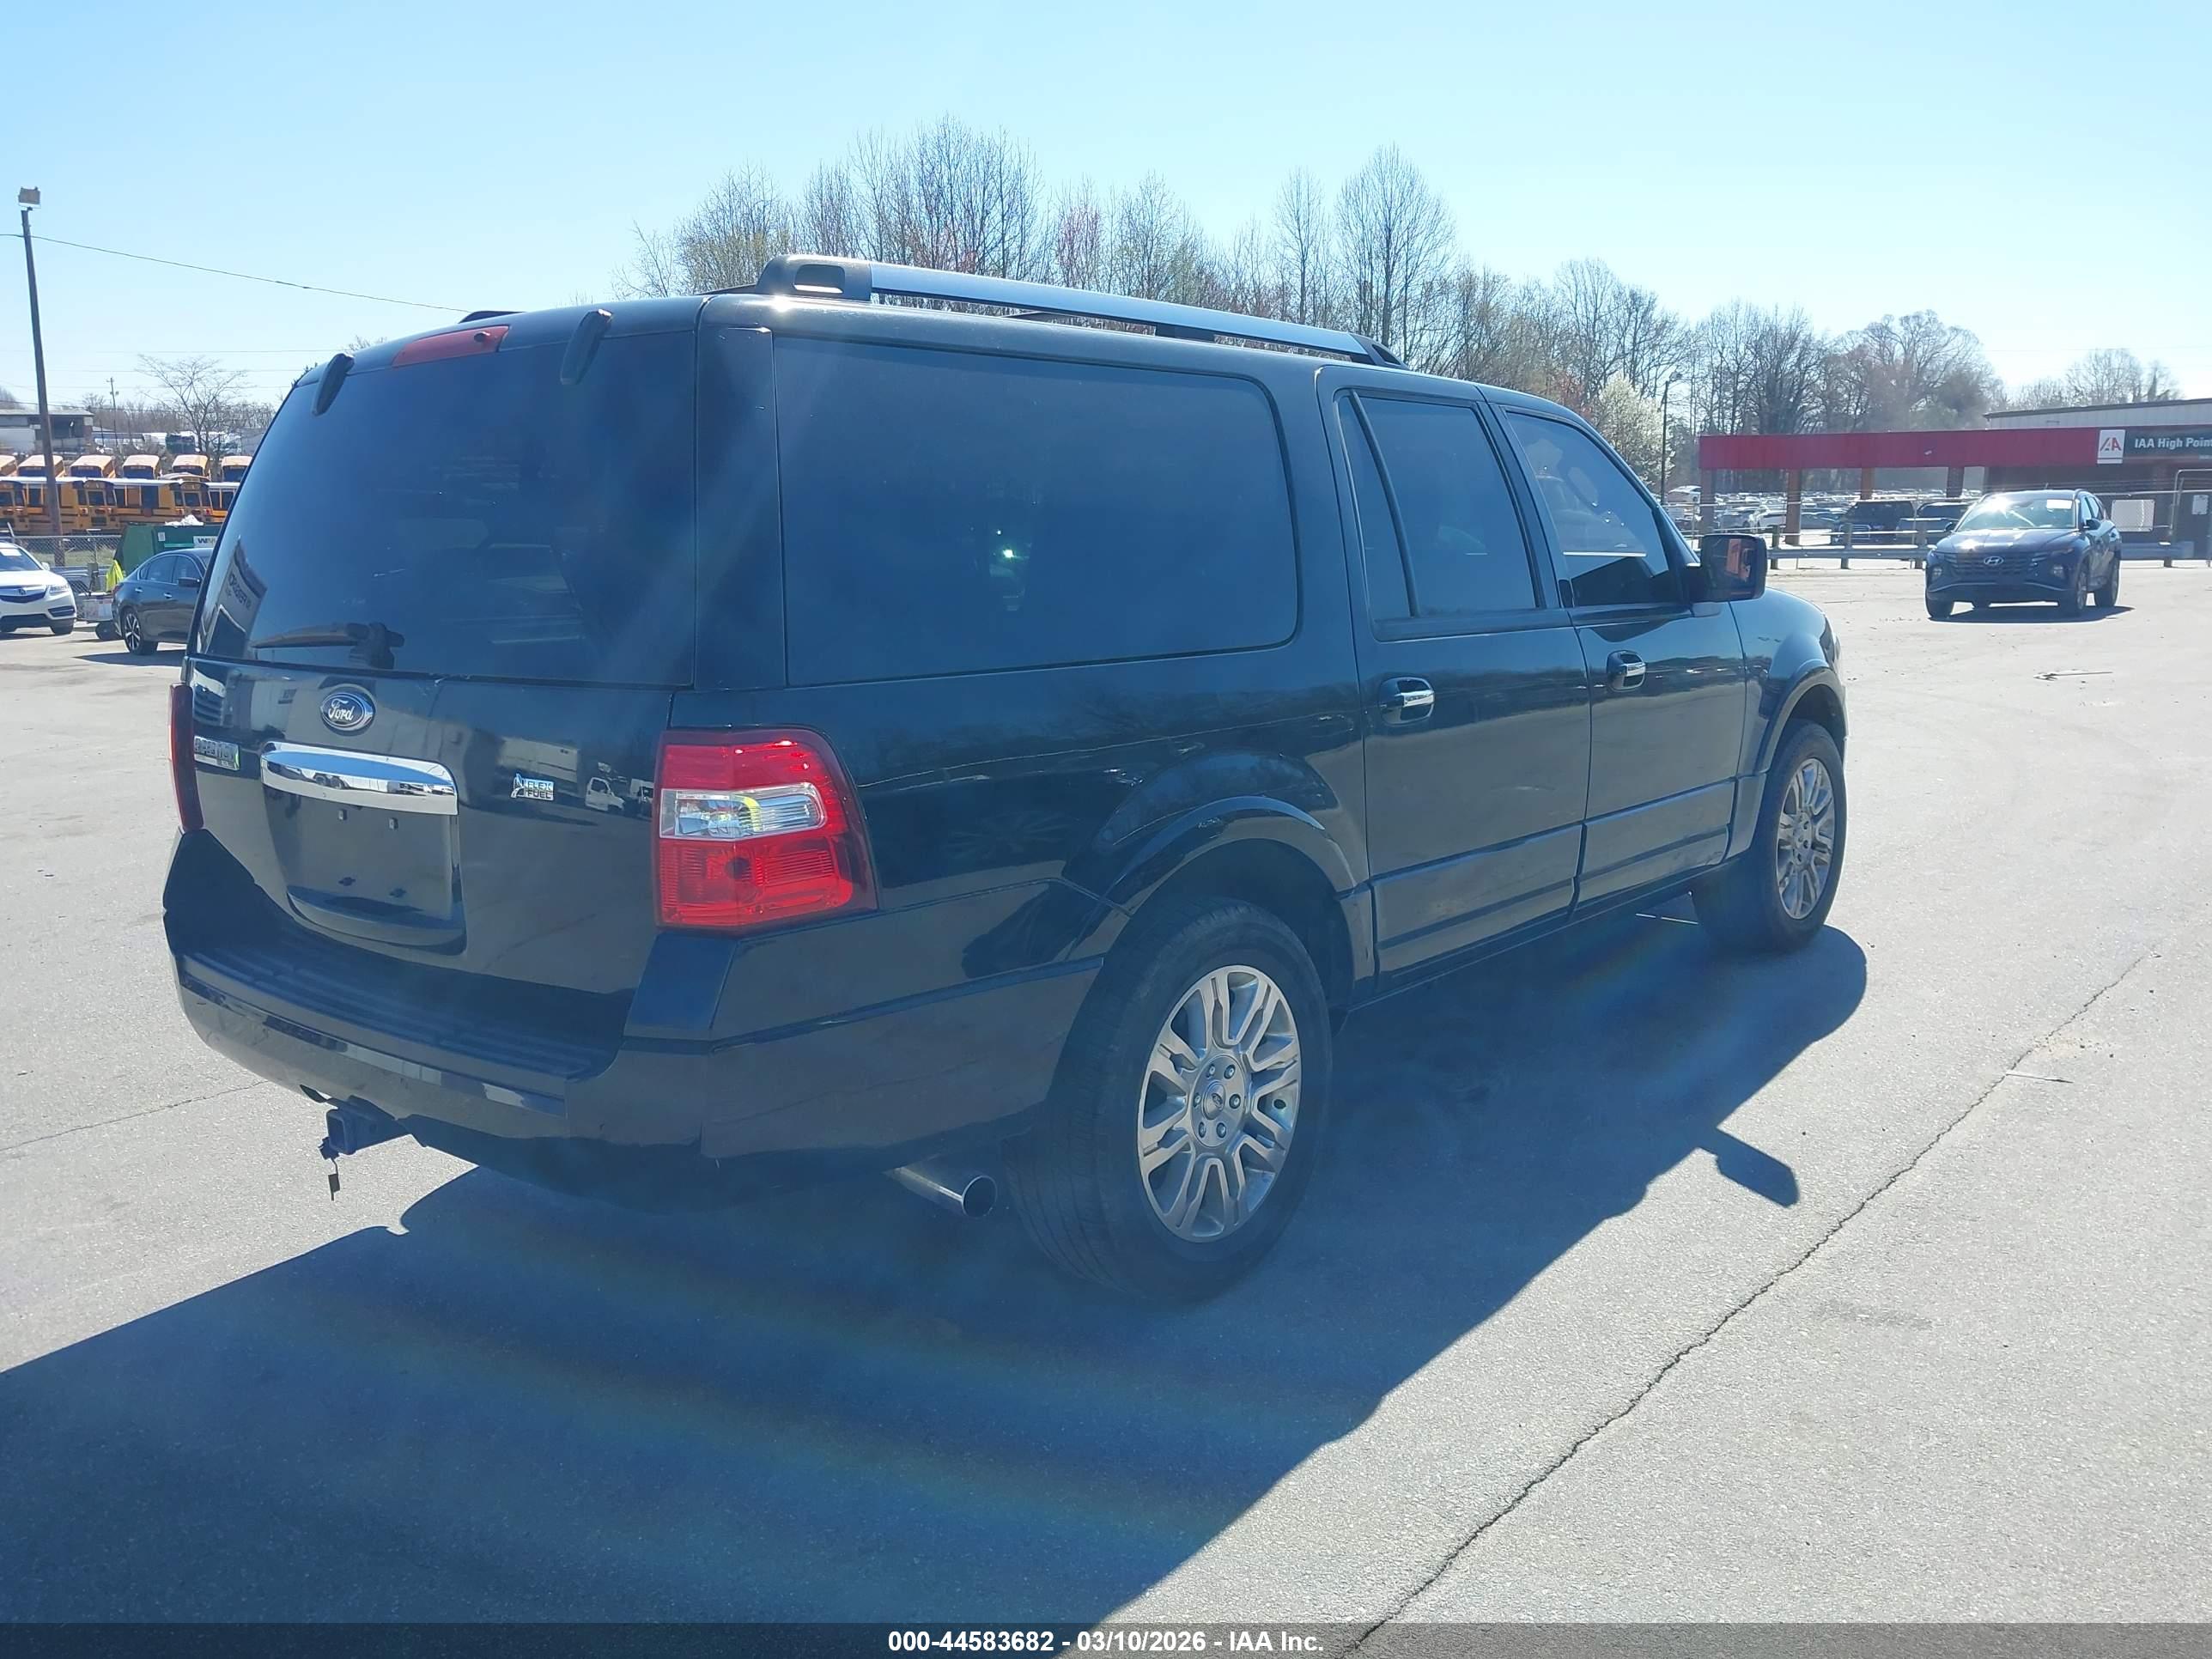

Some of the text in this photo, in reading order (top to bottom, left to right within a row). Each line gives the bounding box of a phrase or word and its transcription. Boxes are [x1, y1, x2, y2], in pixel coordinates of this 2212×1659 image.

[2134, 437, 2155, 448] IAA
[2158, 437, 2183, 450] High
[328, 698, 355, 720] Ford
[527, 781, 553, 791] FLEX
[527, 789, 552, 799] FUEL
